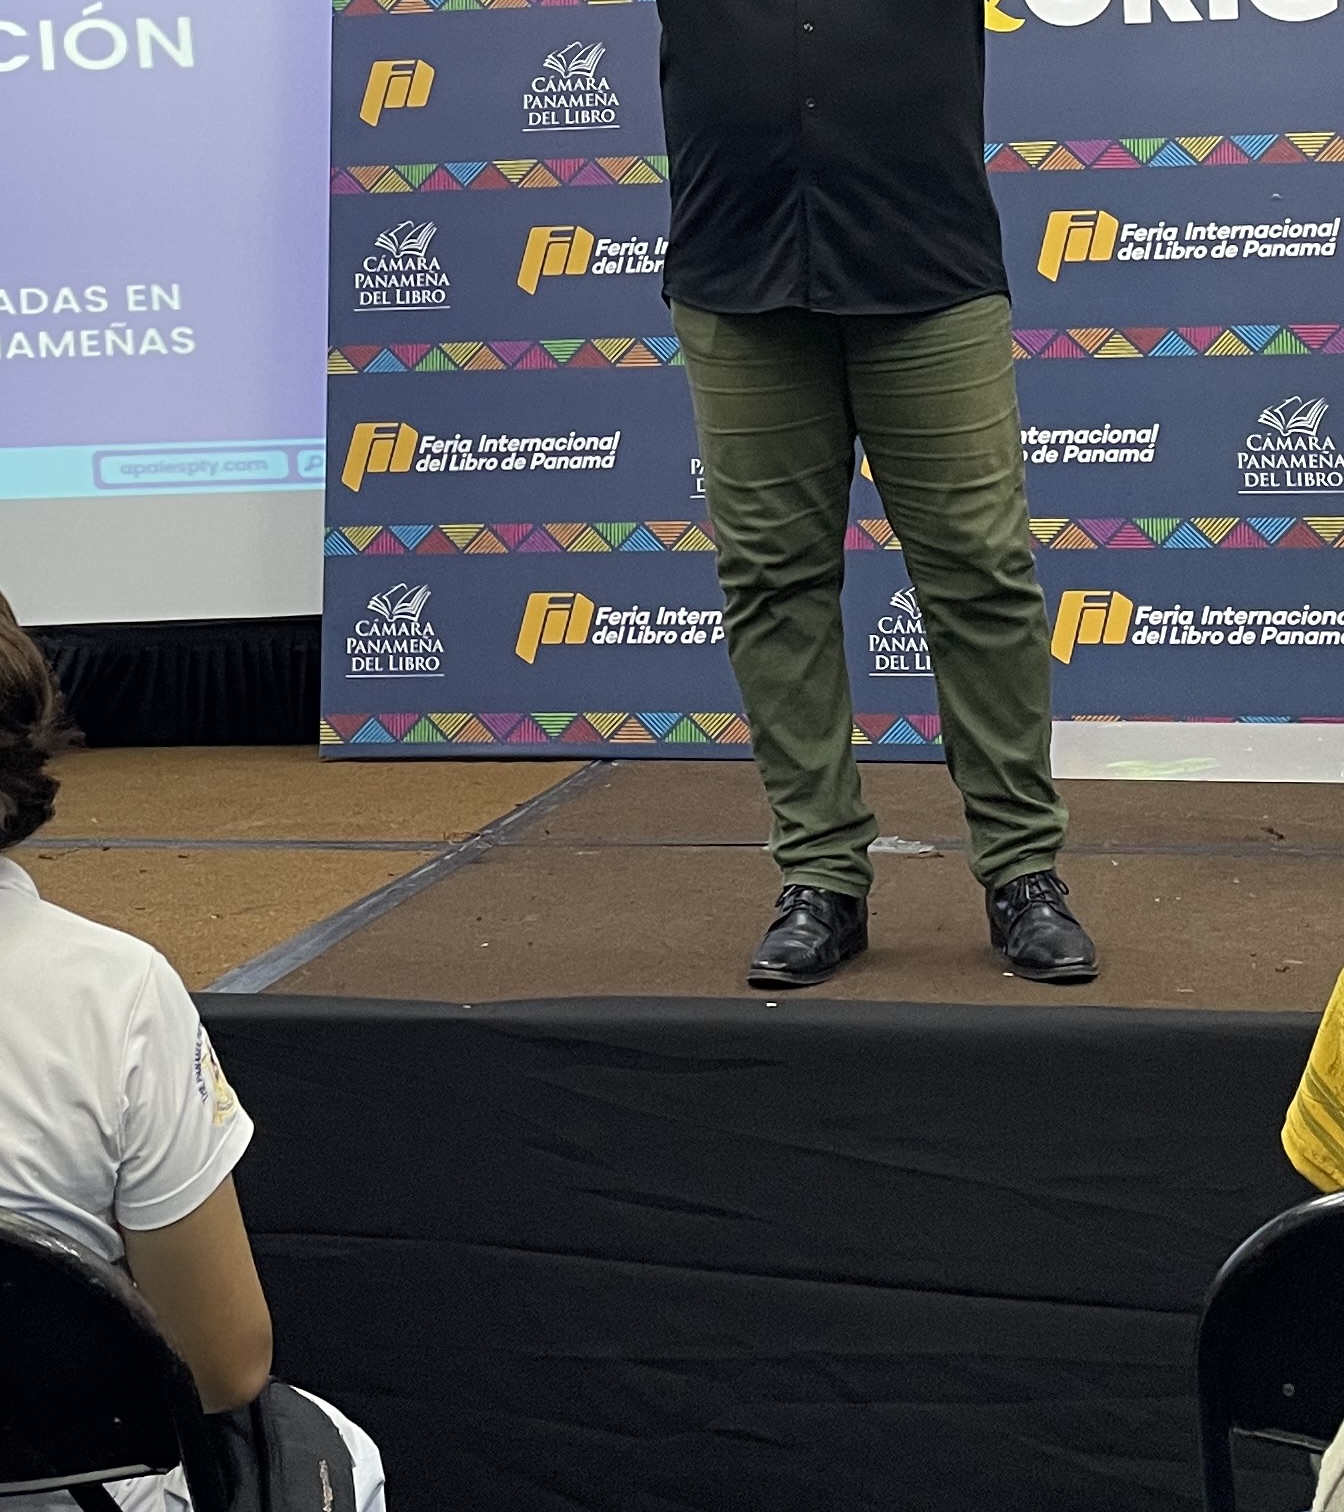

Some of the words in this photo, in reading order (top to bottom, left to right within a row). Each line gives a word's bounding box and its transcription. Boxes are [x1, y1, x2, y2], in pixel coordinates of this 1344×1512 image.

[531, 74, 611, 94] CÁMARA
[523, 92, 620, 110] PANAMEÑA
[528, 111, 560, 126] DEL
[564, 108, 616, 125] LIBRO
[1120, 221, 1179, 243] Feria
[1184, 217, 1341, 243] Internacional
[594, 236, 649, 257] Feria
[1117, 241, 1152, 261] del
[1153, 240, 1208, 260] Libro
[1210, 239, 1239, 259] de
[1242, 236, 1337, 258] Panamá
[363, 252, 441, 274] CÁMARA
[591, 256, 625, 275] del
[625, 254, 665, 274] Libr
[354, 272, 451, 289] PANAMEÑA
[126, 283, 182, 312] EN
[359, 290, 392, 306] DEL
[395, 288, 446, 305] LIBRO
[418, 433, 473, 454] Feria
[477, 430, 621, 456] Internacional
[1030, 444, 1059, 464] de
[1062, 442, 1155, 463] Panamá
[1246, 432, 1336, 455] CÁMARA
[415, 453, 448, 472] del
[448, 452, 499, 472] Libro
[500, 452, 527, 471] de
[529, 452, 616, 470] Panamá
[1243, 472, 1281, 488] DEL
[1285, 470, 1344, 487] LIBRO
[595, 605, 651, 626] Feria
[1134, 604, 1194, 626] Feria
[355, 617, 435, 640] CÁMARA
[591, 625, 626, 645] del
[626, 624, 678, 644] Libro
[680, 625, 707, 644] de
[1131, 625, 1168, 645] del
[1168, 624, 1225, 645] Libro
[1227, 625, 1257, 645] de
[346, 637, 444, 654] PANAMEÑA
[351, 656, 384, 672] DEL
[389, 654, 440, 671] LIBRO
[875, 654, 910, 671] DEL
